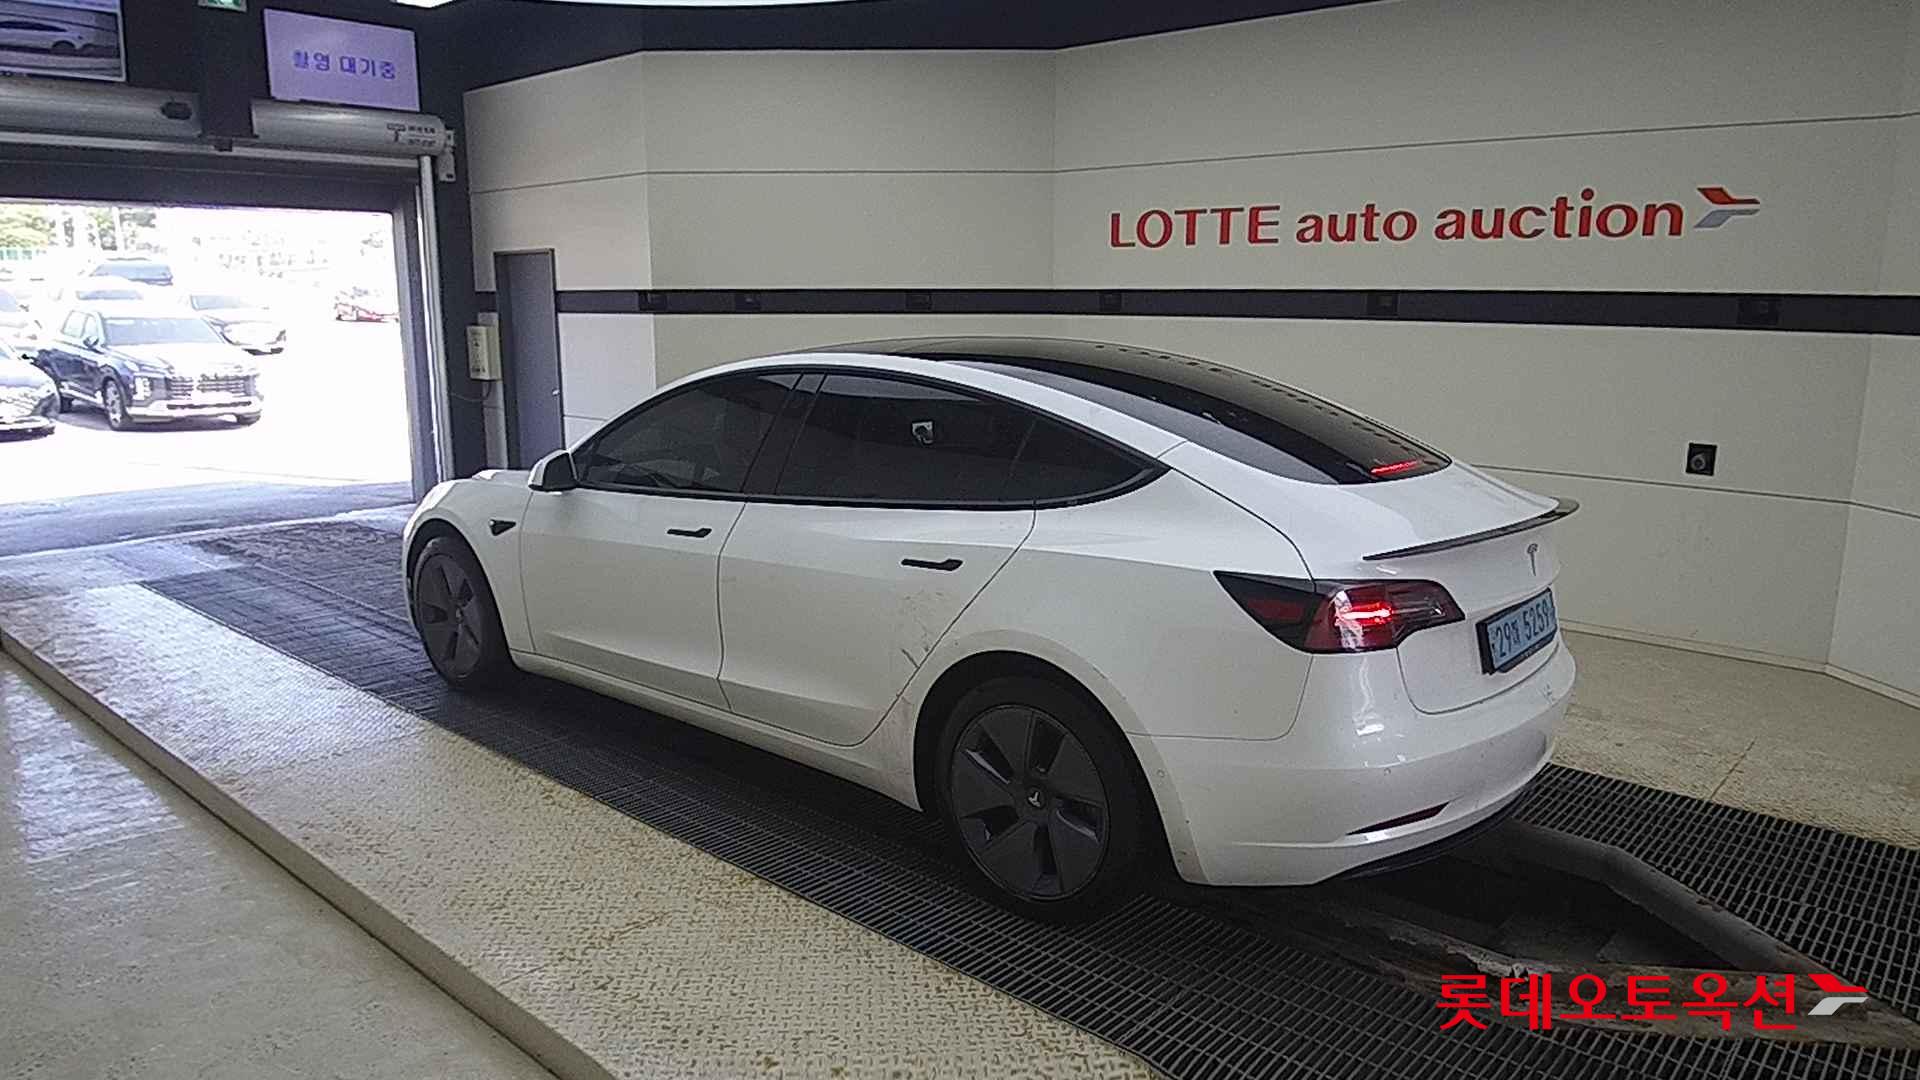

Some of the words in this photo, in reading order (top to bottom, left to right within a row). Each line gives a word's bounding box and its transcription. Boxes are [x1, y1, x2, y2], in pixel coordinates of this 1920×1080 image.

[339, 55, 396, 80] 대기중
[1110, 205, 1280, 248] LOTTE
[1296, 203, 1416, 243] auto
[1434, 188, 1682, 240] auction
[1523, 598, 1550, 640] 5259
